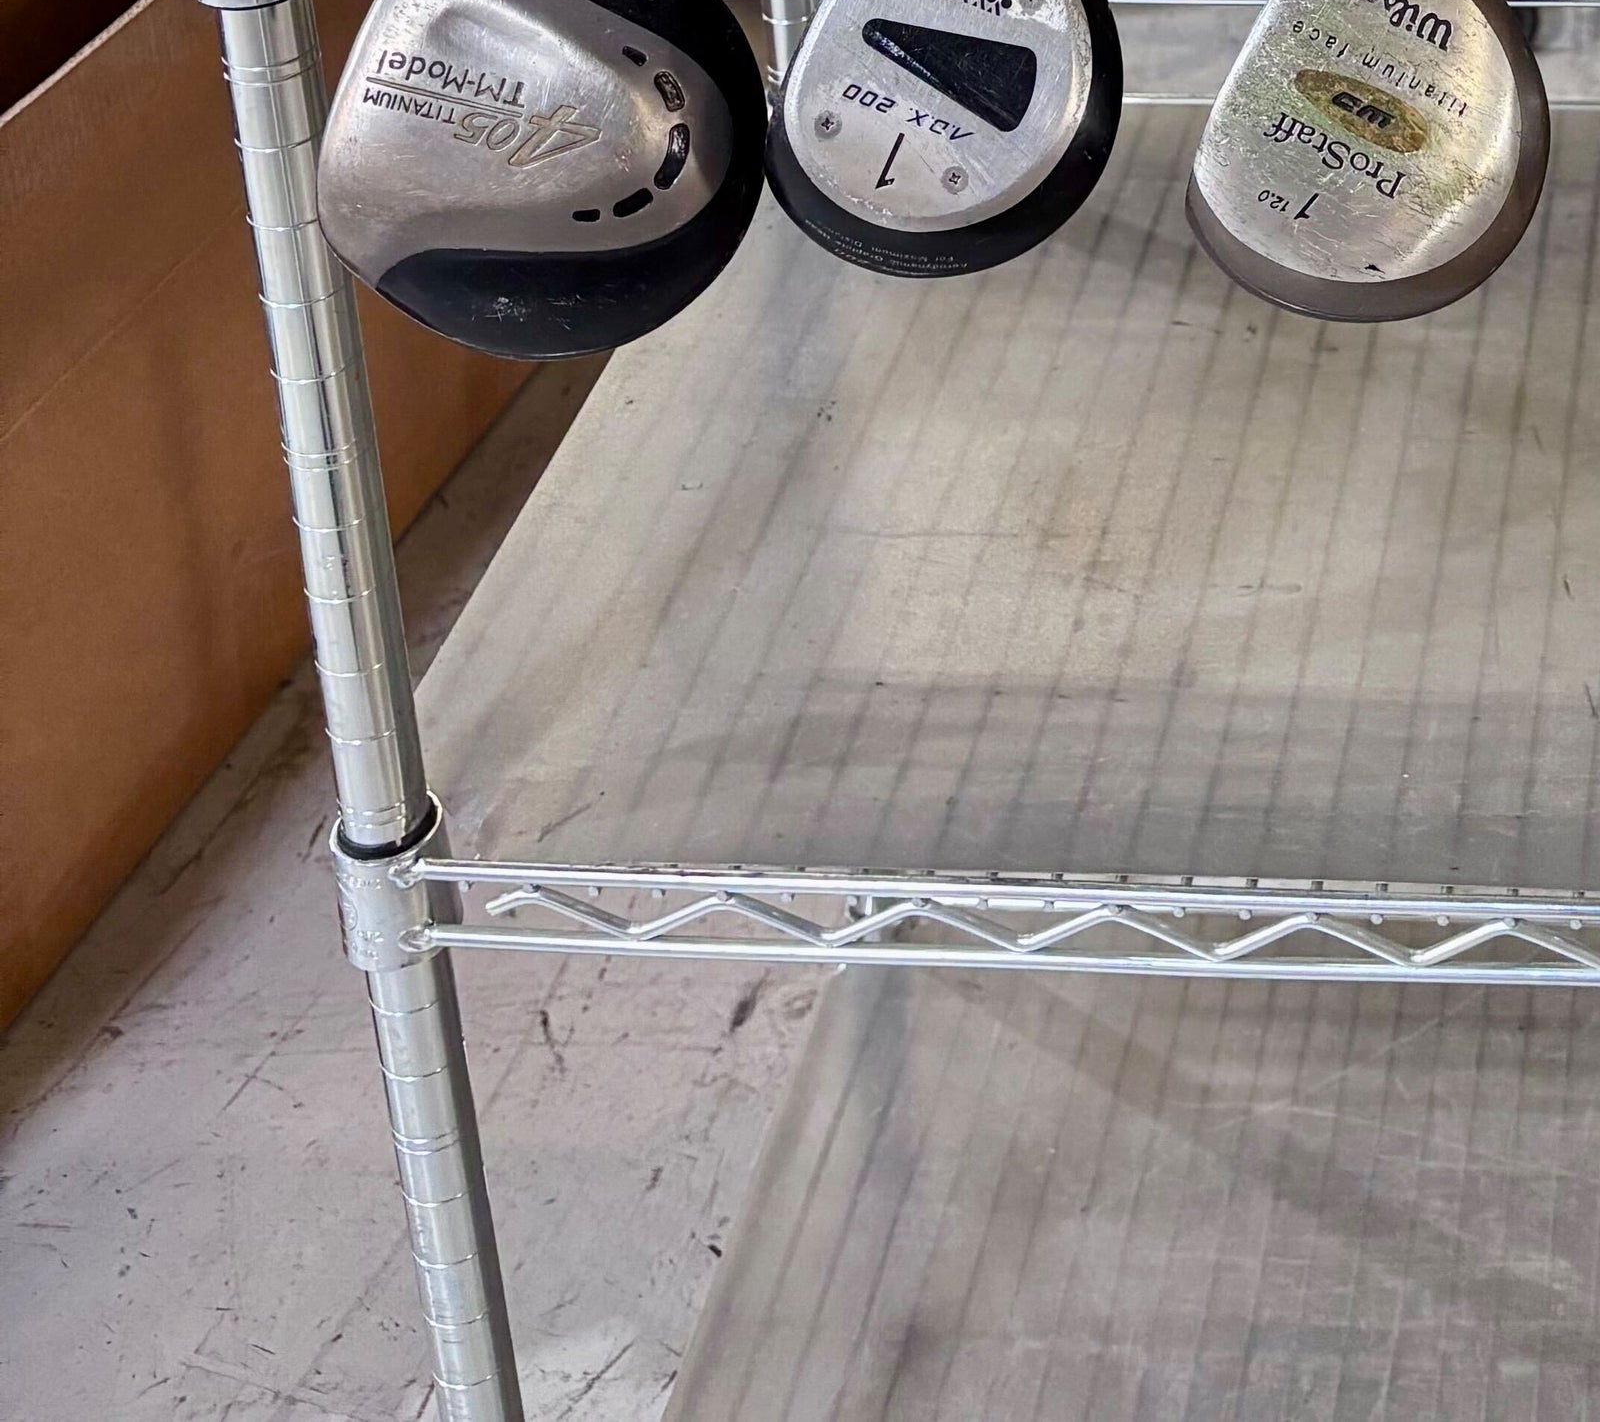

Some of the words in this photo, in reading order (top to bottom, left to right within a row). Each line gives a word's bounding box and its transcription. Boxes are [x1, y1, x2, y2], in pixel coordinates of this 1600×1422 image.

[1292, 20, 1350, 59] face
[377, 50, 525, 109] TM-Model
[842, 83, 897, 114] 200
[1361, 45, 1468, 118] titanium
[363, 87, 456, 125] TITANIUM
[453, 104, 603, 171] 405
[874, 132, 905, 190] 1
[1263, 111, 1407, 200] ProStaff
[1257, 189, 1291, 213] 12.0
[1293, 193, 1320, 221] 1
